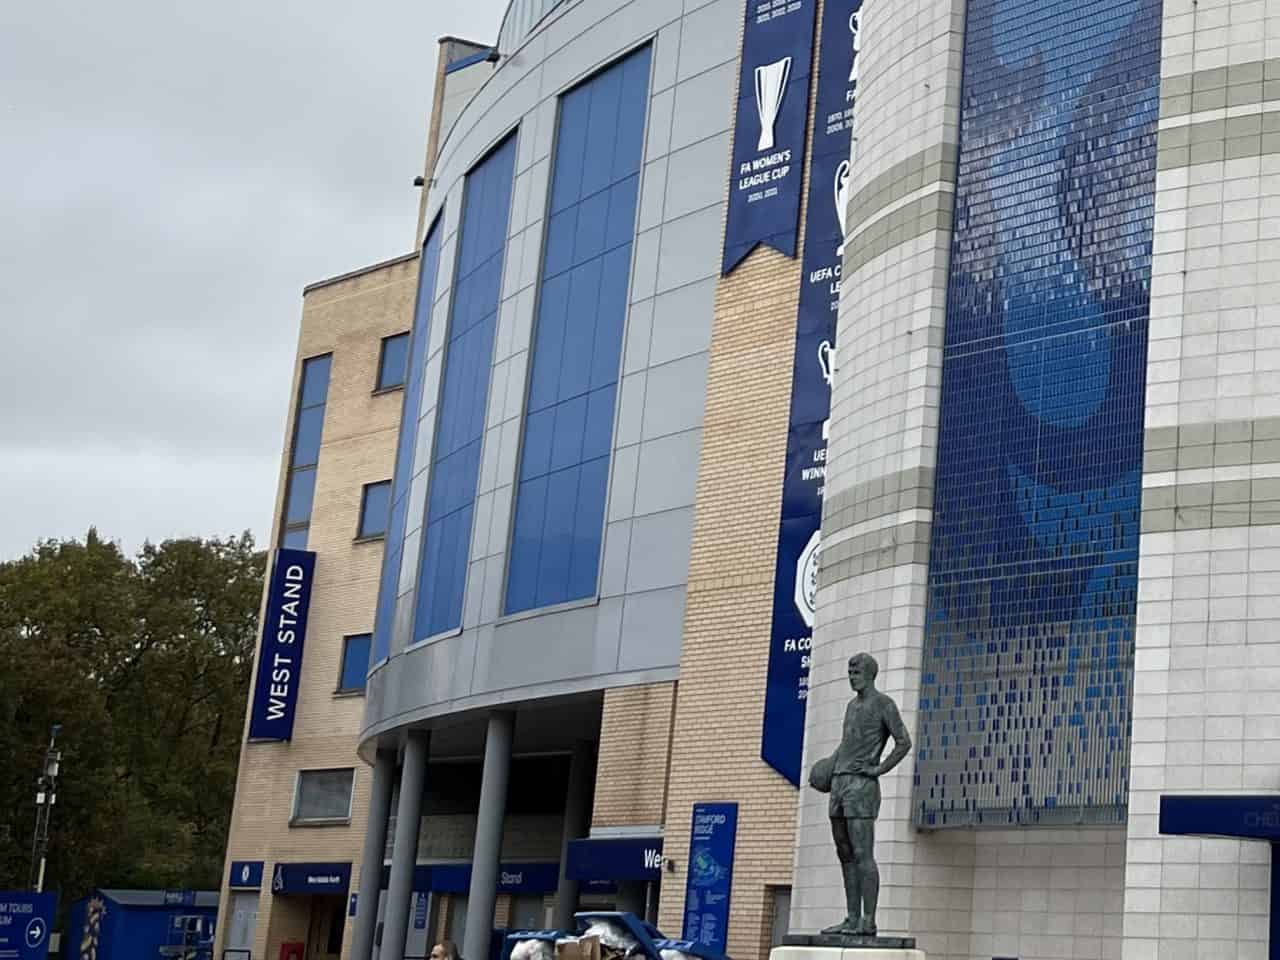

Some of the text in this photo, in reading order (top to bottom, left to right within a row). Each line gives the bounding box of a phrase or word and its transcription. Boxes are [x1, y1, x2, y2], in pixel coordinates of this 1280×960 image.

[739, 165, 790, 190] LEAGUE CUP
[810, 266, 833, 283] UEFA
[266, 565, 304, 721] WEST STAND
[784, 639, 796, 652] FA
